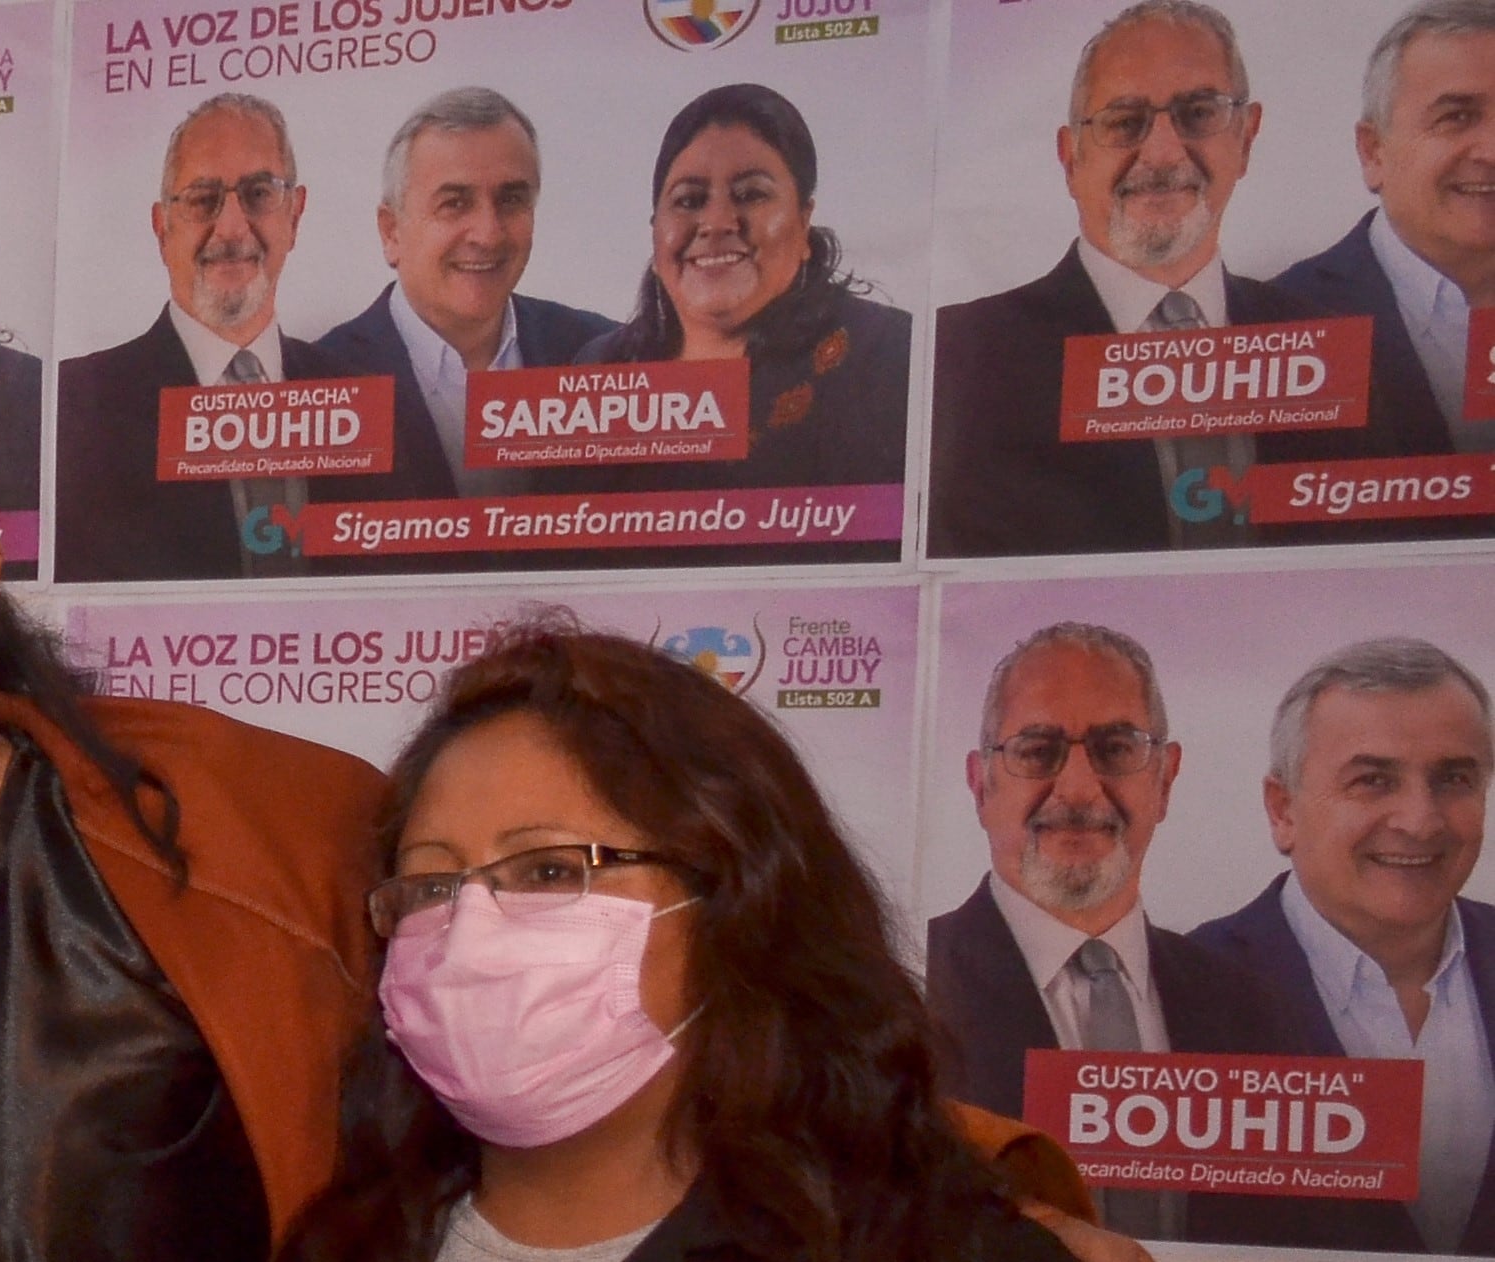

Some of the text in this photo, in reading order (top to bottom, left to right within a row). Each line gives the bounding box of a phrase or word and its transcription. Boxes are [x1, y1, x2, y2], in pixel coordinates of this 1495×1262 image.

[105, 20, 152, 55] LA
[162, 11, 239, 47] VOZ
[249, 4, 300, 40] DE
[312, 0, 383, 33] LOS
[783, 20, 871, 41] Lista 502 A
[105, 28, 437, 93] EN EL CONGRESO
[1105, 329, 1326, 363] GUSTAVO "BACHA"
[558, 371, 650, 393] NATALIA
[1097, 355, 1327, 408] BOUHID
[190, 387, 359, 412] GUSTAVO "BACHA"
[480, 390, 726, 439] SARAPURA
[185, 408, 361, 452] BOUHID
[1085, 404, 1341, 434] Precandidato Diputado Nacional
[176, 453, 373, 475] Precandidato Diputado Nacional
[496, 439, 712, 462] Precandidata Diputada Nacional
[1289, 471, 1473, 514] Sigamos
[332, 511, 471, 550] Sigamos
[483, 499, 746, 538] Transformando
[757, 497, 857, 537] Jujuy
[789, 615, 852, 635] Frente
[107, 635, 152, 668] LA
[162, 633, 239, 667] VOZ
[249, 632, 300, 667] DE
[312, 630, 383, 666] LOS
[782, 635, 883, 657] CAMBIA
[109, 669, 436, 705] EN EL CONGRESO
[778, 658, 882, 685] JUJUY
[785, 691, 873, 706] Lista 502 A
[1076, 1064, 1364, 1096] GUSTAVO "BACHA"
[1068, 1093, 1367, 1155] BOUHID
[1076, 1160, 1384, 1191] ecandidato Diputado Nacional
